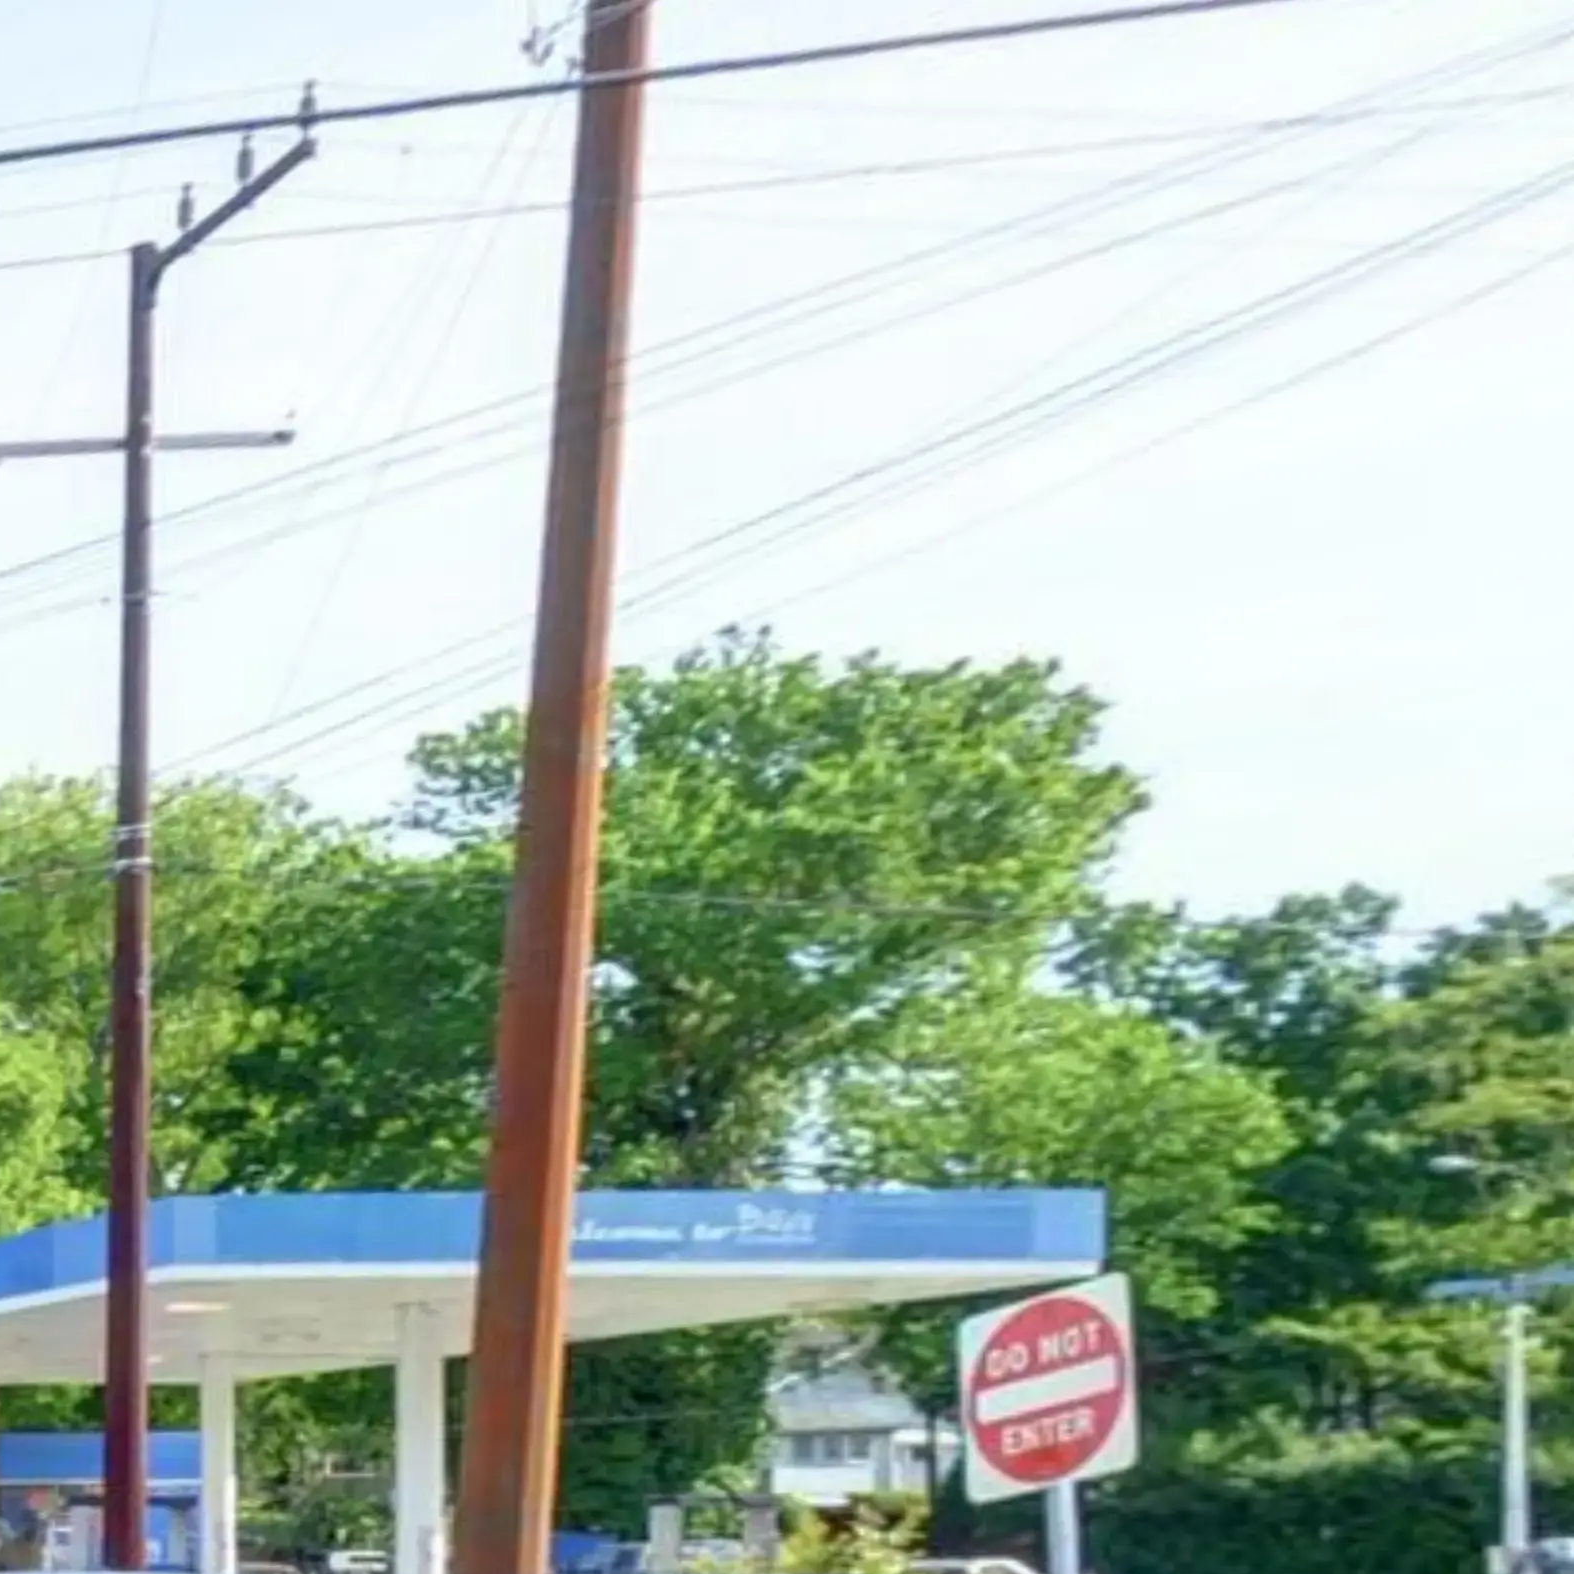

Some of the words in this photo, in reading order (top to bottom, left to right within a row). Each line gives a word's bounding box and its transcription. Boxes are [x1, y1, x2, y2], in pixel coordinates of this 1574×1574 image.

[985, 1342, 1029, 1381] DO
[1038, 1321, 1101, 1365] NOT
[1001, 1407, 1095, 1456] ENTER
